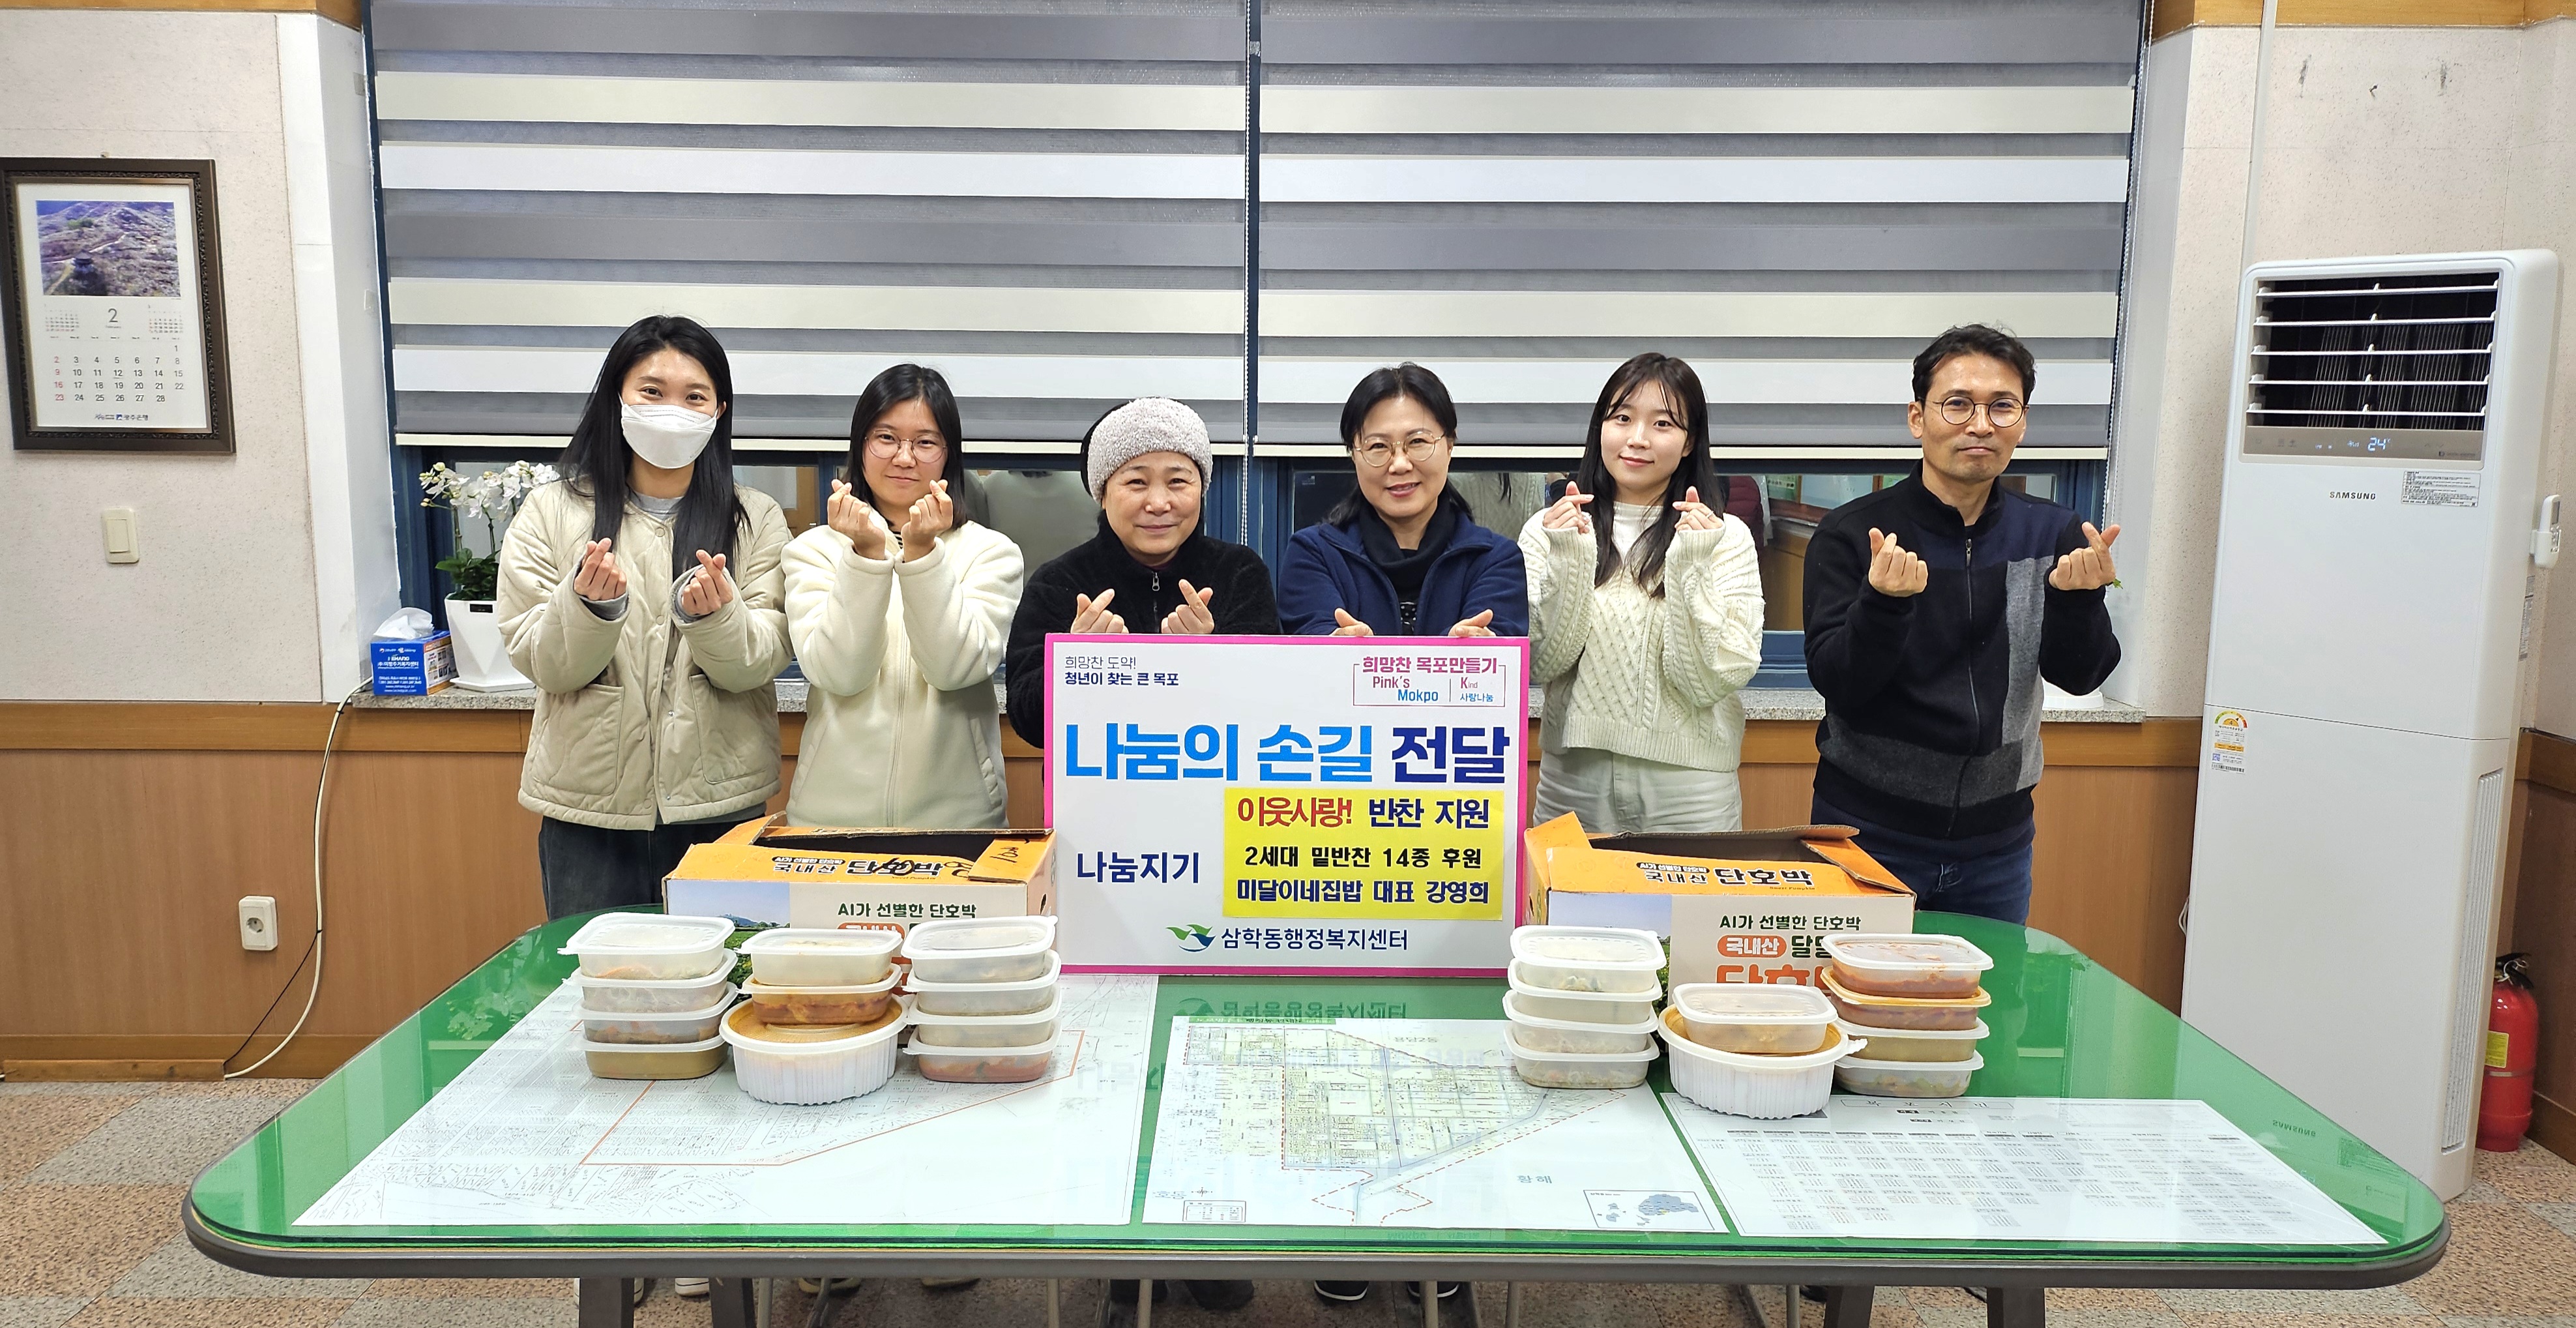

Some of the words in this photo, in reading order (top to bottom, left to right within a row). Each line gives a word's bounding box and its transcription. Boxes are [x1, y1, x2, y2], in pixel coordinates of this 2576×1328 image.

[108, 308, 118, 322] 2
[2329, 491, 2377, 500] SAMSUNG
[1064, 655, 1104, 670] 희망찬
[1107, 656, 1136, 670] 도약!
[1362, 656, 1412, 673] 희망찬
[1416, 657, 1497, 674] 목포만들기
[1064, 671, 1103, 685] 청년이
[1107, 671, 1133, 686] 찾는
[1137, 672, 1150, 686] 큰
[1153, 672, 1179, 686] 목포
[1372, 675, 1410, 688] Pink's
[1398, 688, 1439, 703] Mokpo
[1459, 692, 1494, 702] 사랑나눔
[1065, 722, 1239, 782] 나눔의
[1257, 724, 1373, 782] 손길
[1392, 725, 1510, 784] 전달
[1238, 797, 1353, 827] 이웃사랑!
[1368, 797, 1425, 828] 반찬
[1434, 798, 1489, 829] 지원
[1244, 846, 1299, 868] 2세대
[1311, 846, 1371, 868] 밑반찬
[1383, 848, 1430, 868] 14종
[1441, 848, 1482, 869] 후원
[774, 863, 837, 875] 국내산
[847, 859, 944, 877] 단호박
[1077, 851, 1200, 885] 나눔지기
[1645, 870, 1707, 885] 국내산
[1714, 867, 1814, 887] 단호박
[1237, 878, 1364, 903] 미달이네집밥
[1373, 880, 1415, 904] 대표
[1426, 880, 1489, 904] 강영희
[838, 902, 871, 917] AI가
[876, 902, 924, 918] 선별한
[929, 904, 978, 919] 단호박
[1719, 915, 1753, 930] AI가
[1759, 915, 1807, 931] 선별한
[1813, 916, 1862, 931] 단호박
[1221, 926, 1408, 952] 삼학동행정복지센터
[1726, 937, 1780, 956] 국내산
